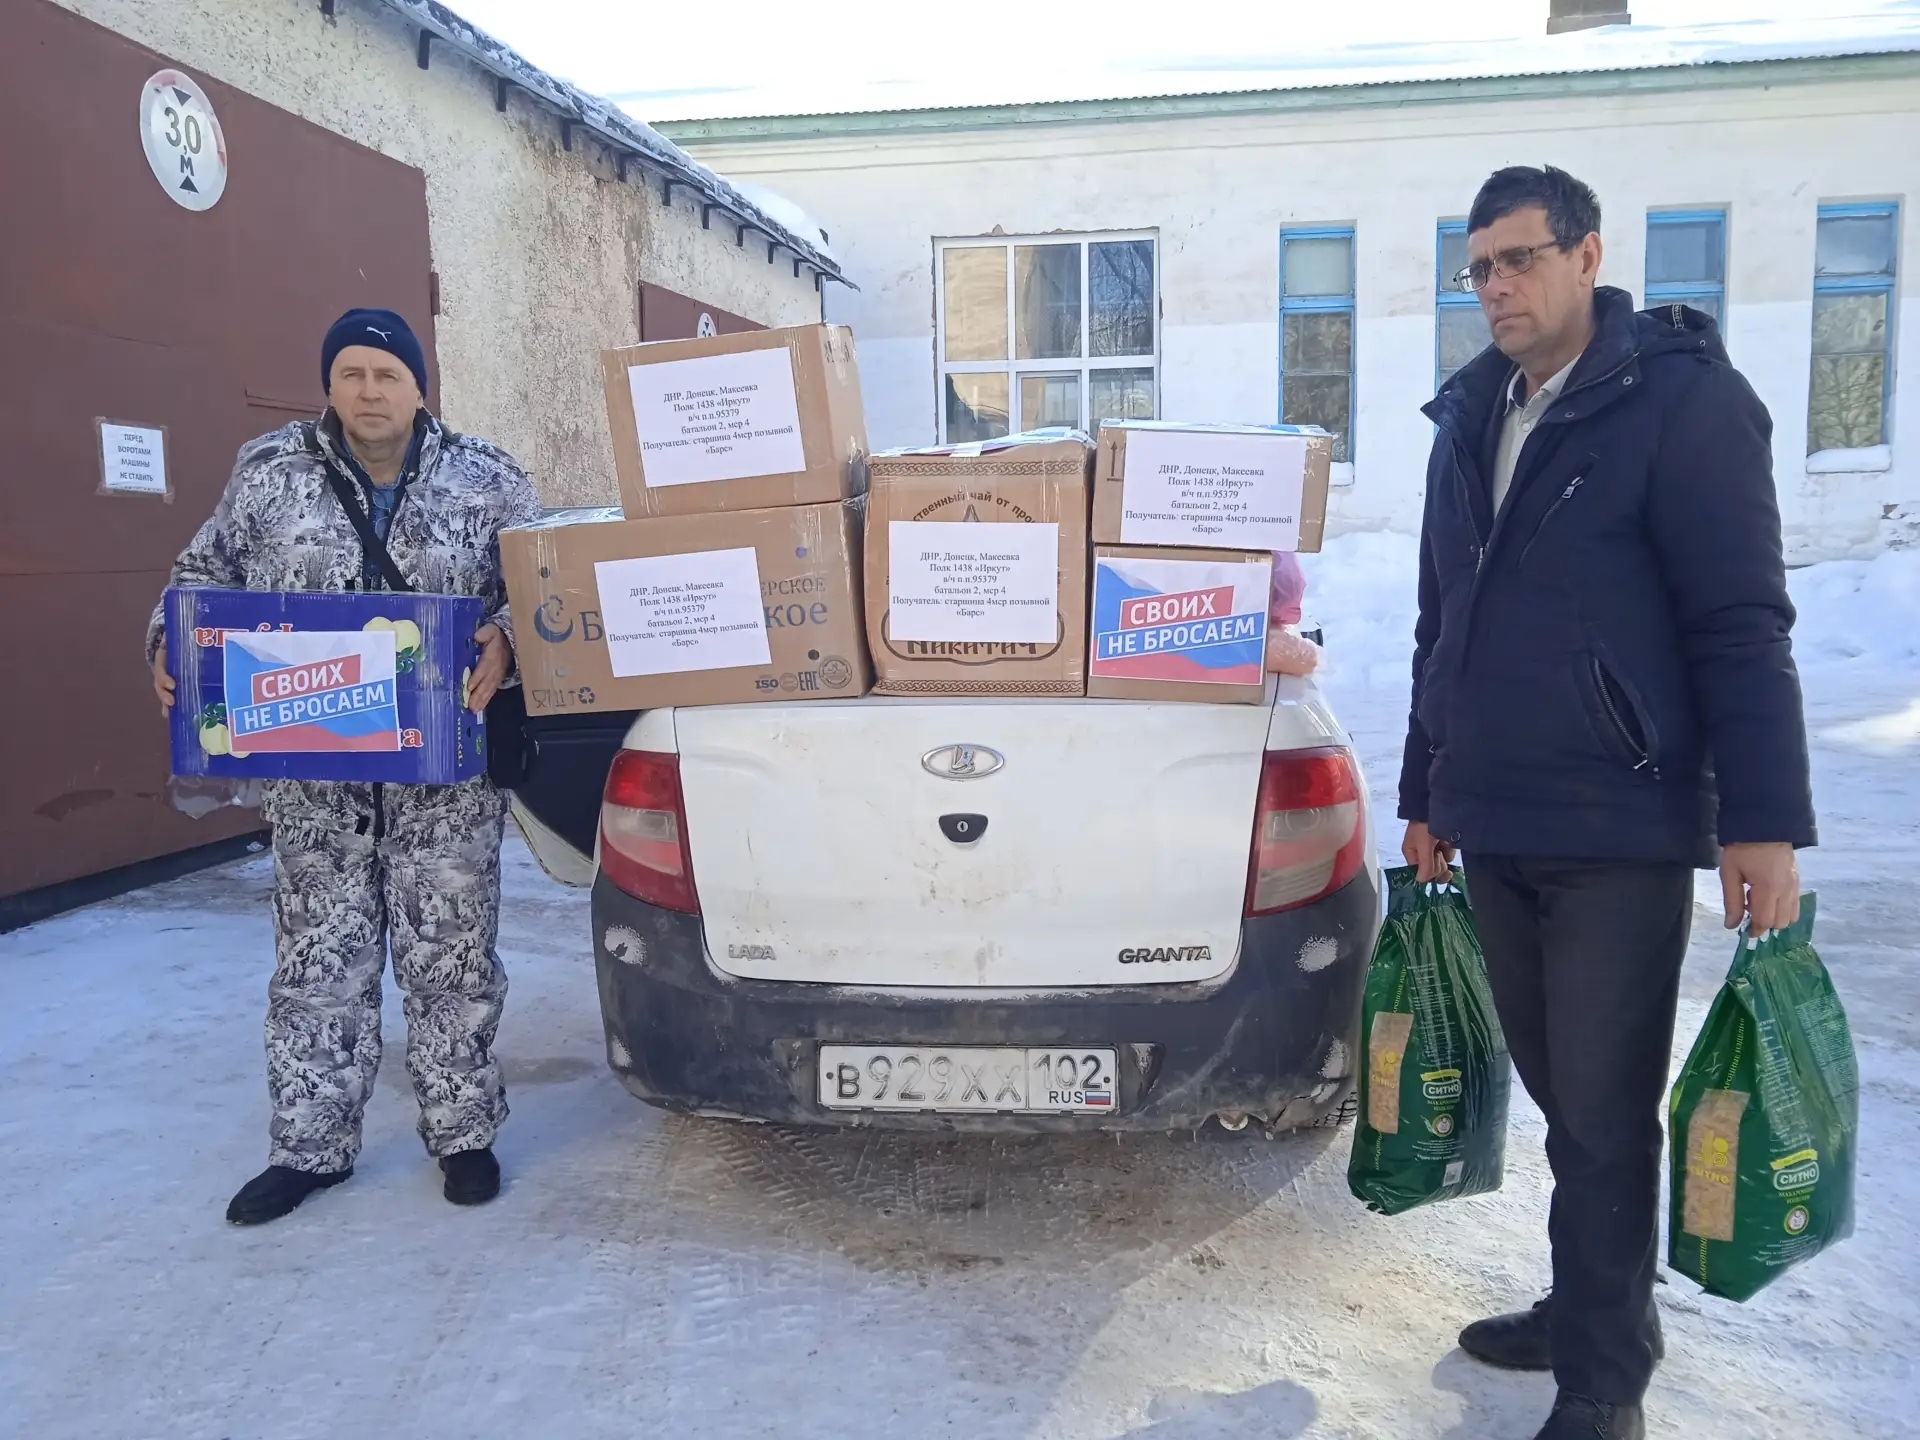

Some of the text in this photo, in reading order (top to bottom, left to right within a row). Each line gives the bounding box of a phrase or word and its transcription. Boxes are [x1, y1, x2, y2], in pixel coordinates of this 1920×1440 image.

[664, 384, 758, 403] ДНР, Донецк, Макеевка
[673, 397, 751, 413] Полк 1438 «Иркут»
[688, 413, 700, 422] в/ч
[681, 418, 750, 435] батальон 2, мср 4
[124, 433, 144, 444] ПЕРЕД
[733, 431, 753, 441] 4мср
[117, 445, 151, 456] ВОРОТАМИ
[705, 444, 733, 455] «Барс»
[121, 458, 150, 468] МАШИНЫ
[1158, 465, 1264, 476] ДНР, Донецк, Макеевка
[128, 472, 154, 482] СТАВИТЬ
[1168, 477, 1254, 489] Полк 1438 «Иркут»
[1181, 489, 1194, 498] в/ч
[970, 491, 993, 502] чай
[996, 497, 1010, 508] от
[1171, 500, 1247, 512] батальон 2, мср 4
[1225, 514, 1247, 524] 4мср
[1192, 524, 1223, 535] «Барс»
[920, 552, 1020, 562] ДНР, Донецк, Макеевка
[929, 563, 1011, 574] Полк 1438 «Иркут»
[943, 575, 955, 583] в/ч
[629, 581, 724, 598] ДНР, Донецк, Макеевка
[934, 586, 1006, 596] батальон 2, мср 4
[639, 593, 717, 607] Полк 1438 «Иркут»
[986, 597, 1007, 607] 4мср
[654, 607, 666, 616] в/ч
[956, 609, 985, 618] «Барс»
[1130, 592, 1216, 625] СВОИХ
[647, 614, 716, 628] батальон 2, мср 4
[698, 625, 718, 635] 4мср
[1107, 616, 1255, 655] НЕ БРОСАЕМ
[671, 638, 699, 648] «Барс»
[261, 662, 345, 699] СВОИХ
[755, 678, 779, 689] ISO
[244, 684, 386, 730] НЕ БРОСАЕМ
[728, 944, 776, 962] LADA
[1118, 945, 1212, 964] GRANTA
[1033, 1054, 1103, 1090] 102
[1428, 1084, 1459, 1095] СИТНО
[1049, 1091, 1084, 1104] RUS
[1780, 1168, 1816, 1184] СИТНО
